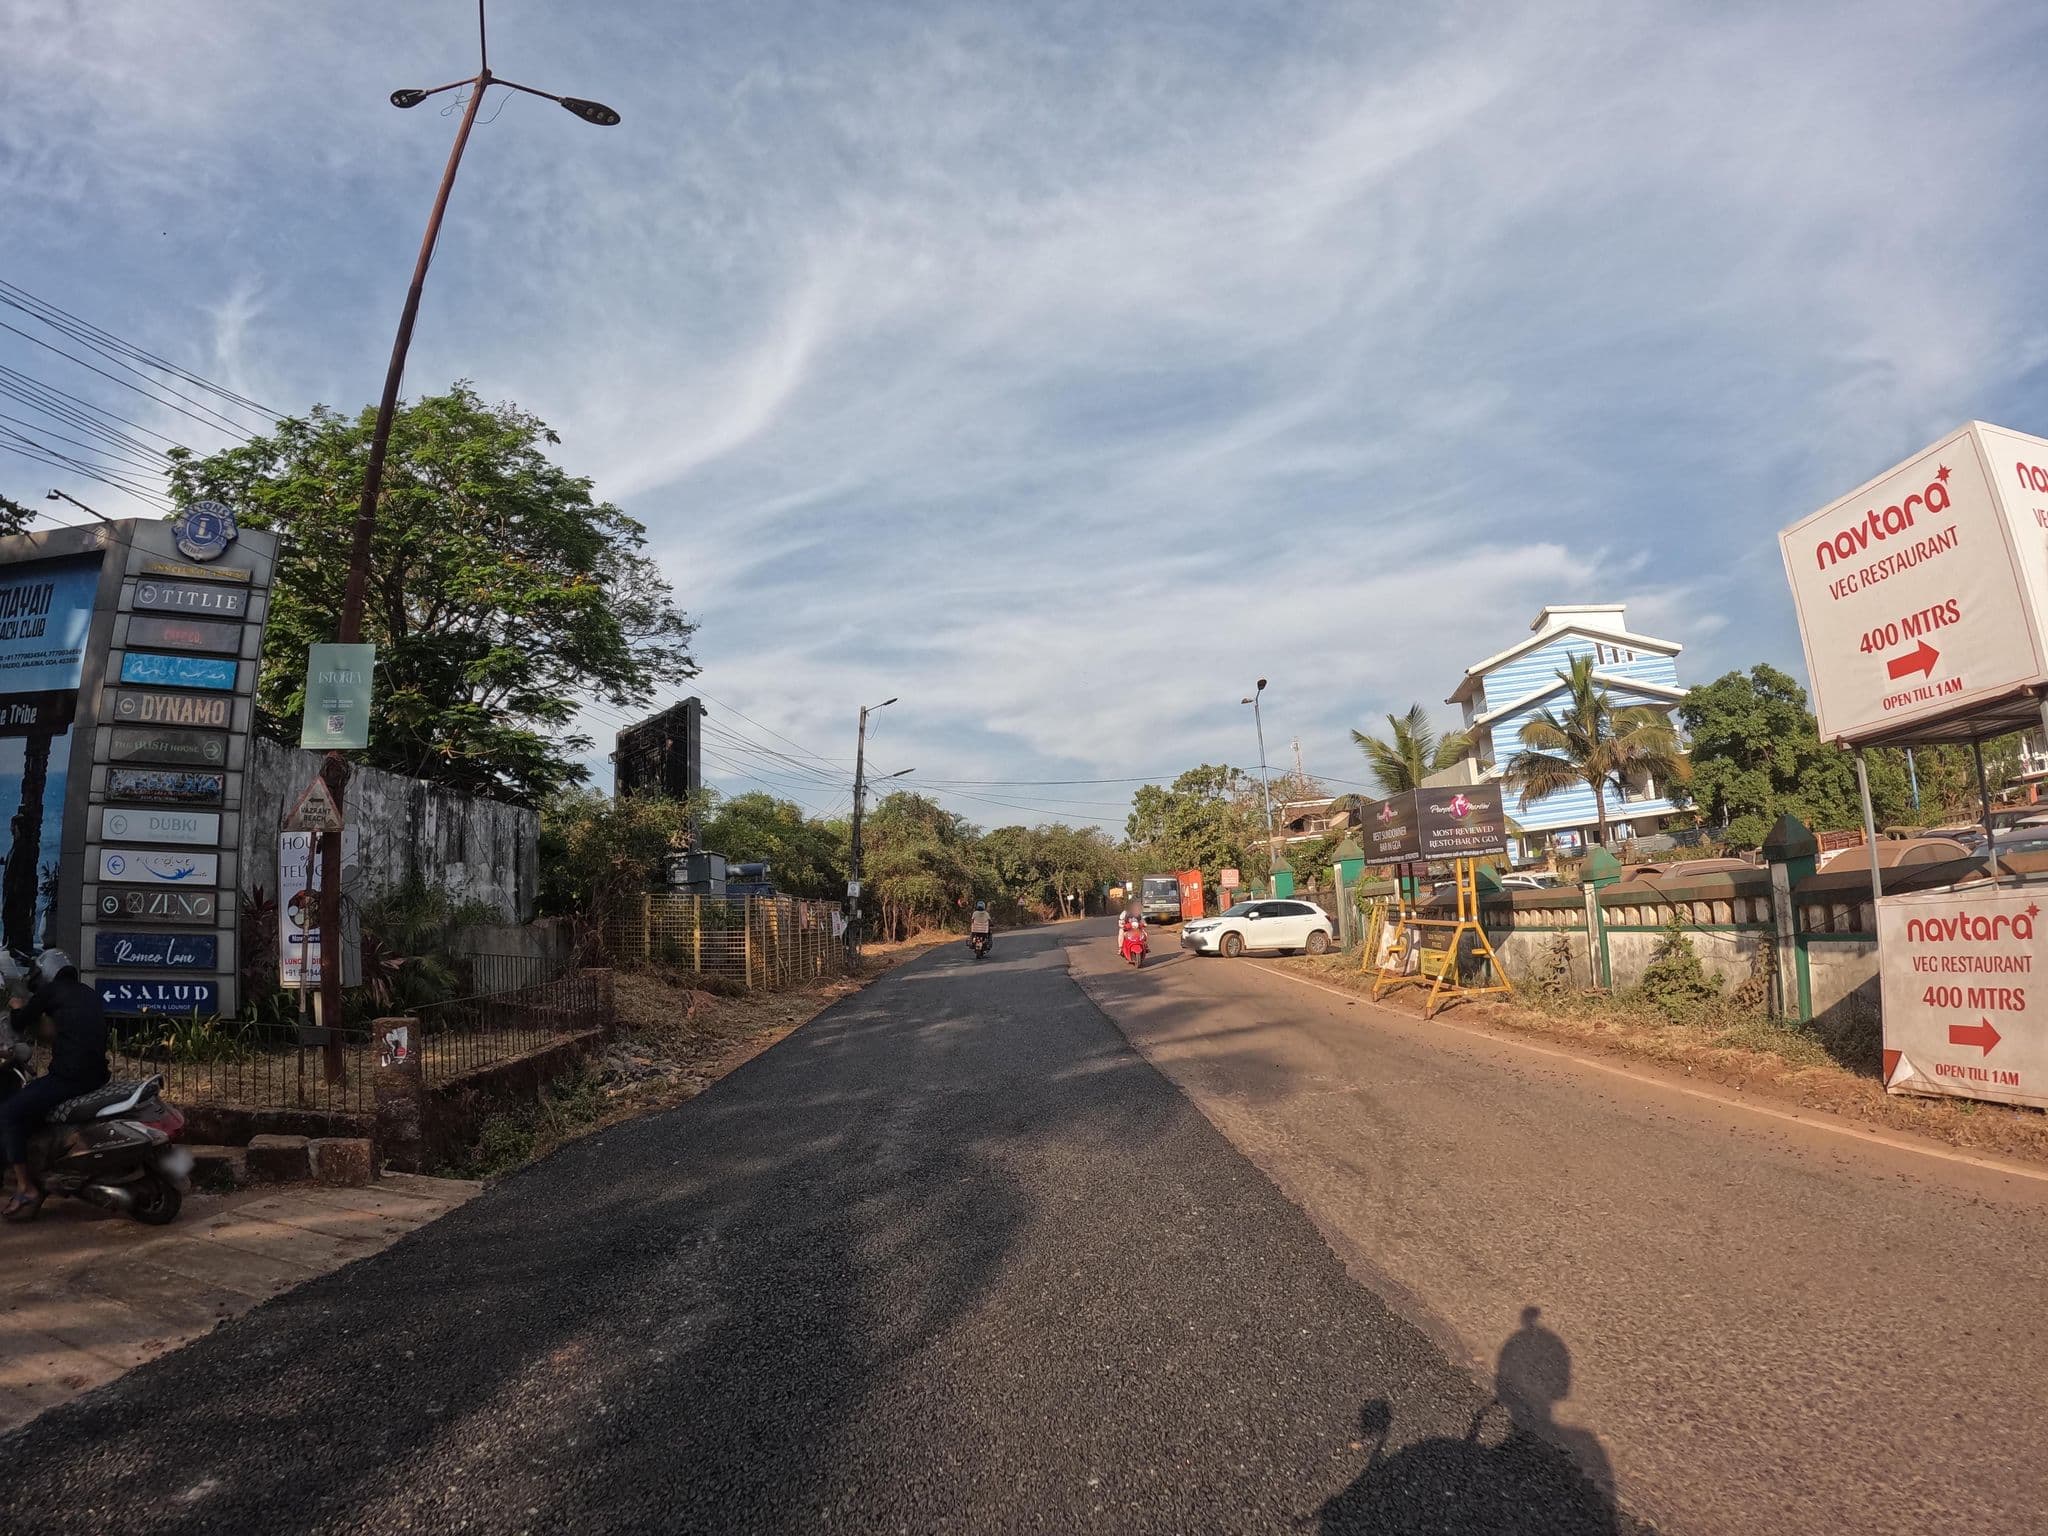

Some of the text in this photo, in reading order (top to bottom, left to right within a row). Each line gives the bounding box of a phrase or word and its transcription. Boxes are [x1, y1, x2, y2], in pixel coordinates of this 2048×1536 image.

[1816, 482, 1951, 570] navtara
[2032, 508, 2048, 529] VE
[1829, 525, 1958, 600] VEG RESTAURANT
[162, 590, 238, 609] TITLIE
[19, 618, 46, 638] CLUB
[1860, 599, 1961, 653] 400 MTRS
[1883, 692, 1912, 711] OPEN
[1914, 685, 1935, 703] TILL
[11, 704, 38, 725] Tribe
[140, 695, 225, 724] DYNAMO
[149, 816, 197, 832] DUBKI
[1432, 825, 1495, 838] MOST REVIEWED
[1472, 837, 1482, 845] IN
[1483, 834, 1499, 844] GOA
[149, 893, 211, 917] ZENO
[1907, 912, 2033, 942] navtara
[114, 938, 196, 965] Romeo Lane
[1912, 956, 2032, 973] VEG RESTAURANT
[120, 984, 209, 1001] SALUD
[1923, 986, 2026, 1011] 400 MTRS
[1935, 1063, 1964, 1078] OPEN
[1967, 1067, 1989, 1082] TILL
